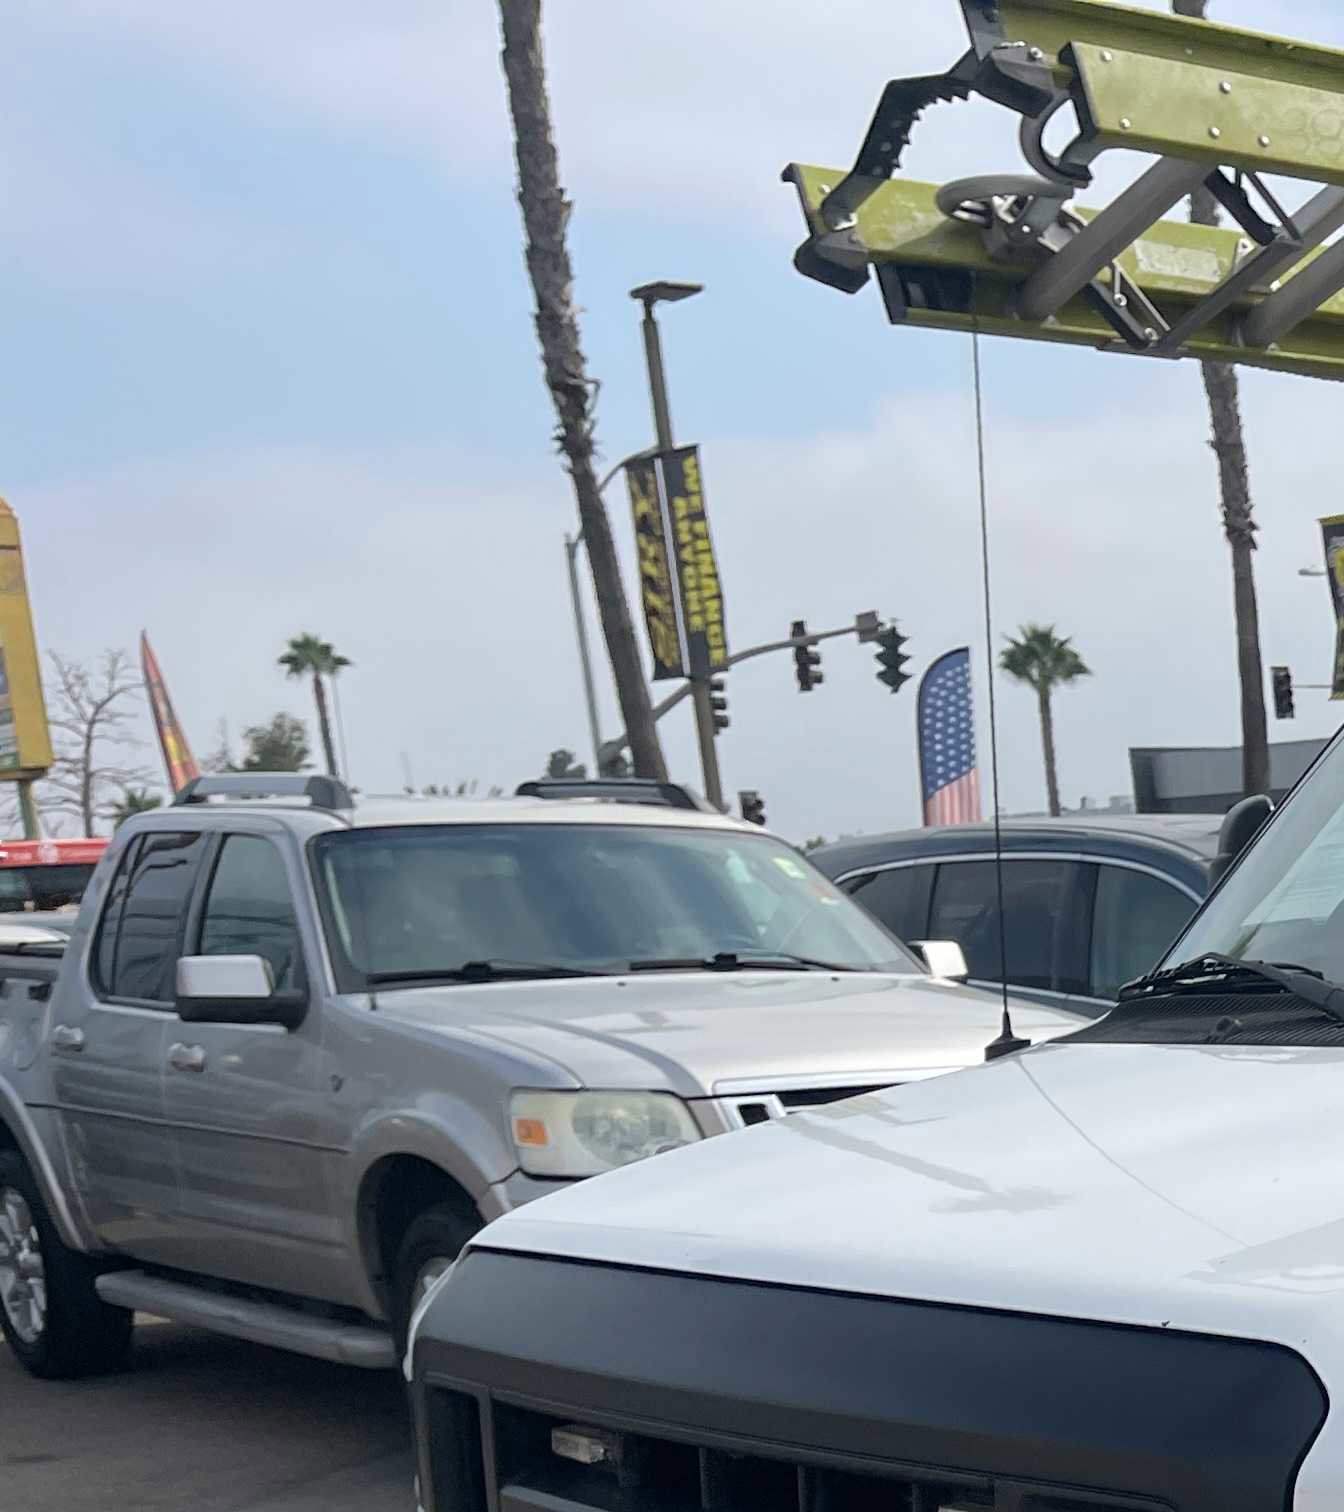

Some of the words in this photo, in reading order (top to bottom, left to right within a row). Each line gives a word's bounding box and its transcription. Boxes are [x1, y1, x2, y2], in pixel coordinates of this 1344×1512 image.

[682, 454, 704, 513] WE
[672, 495, 706, 633] ANYONE
[692, 520, 728, 668] FINANCE
